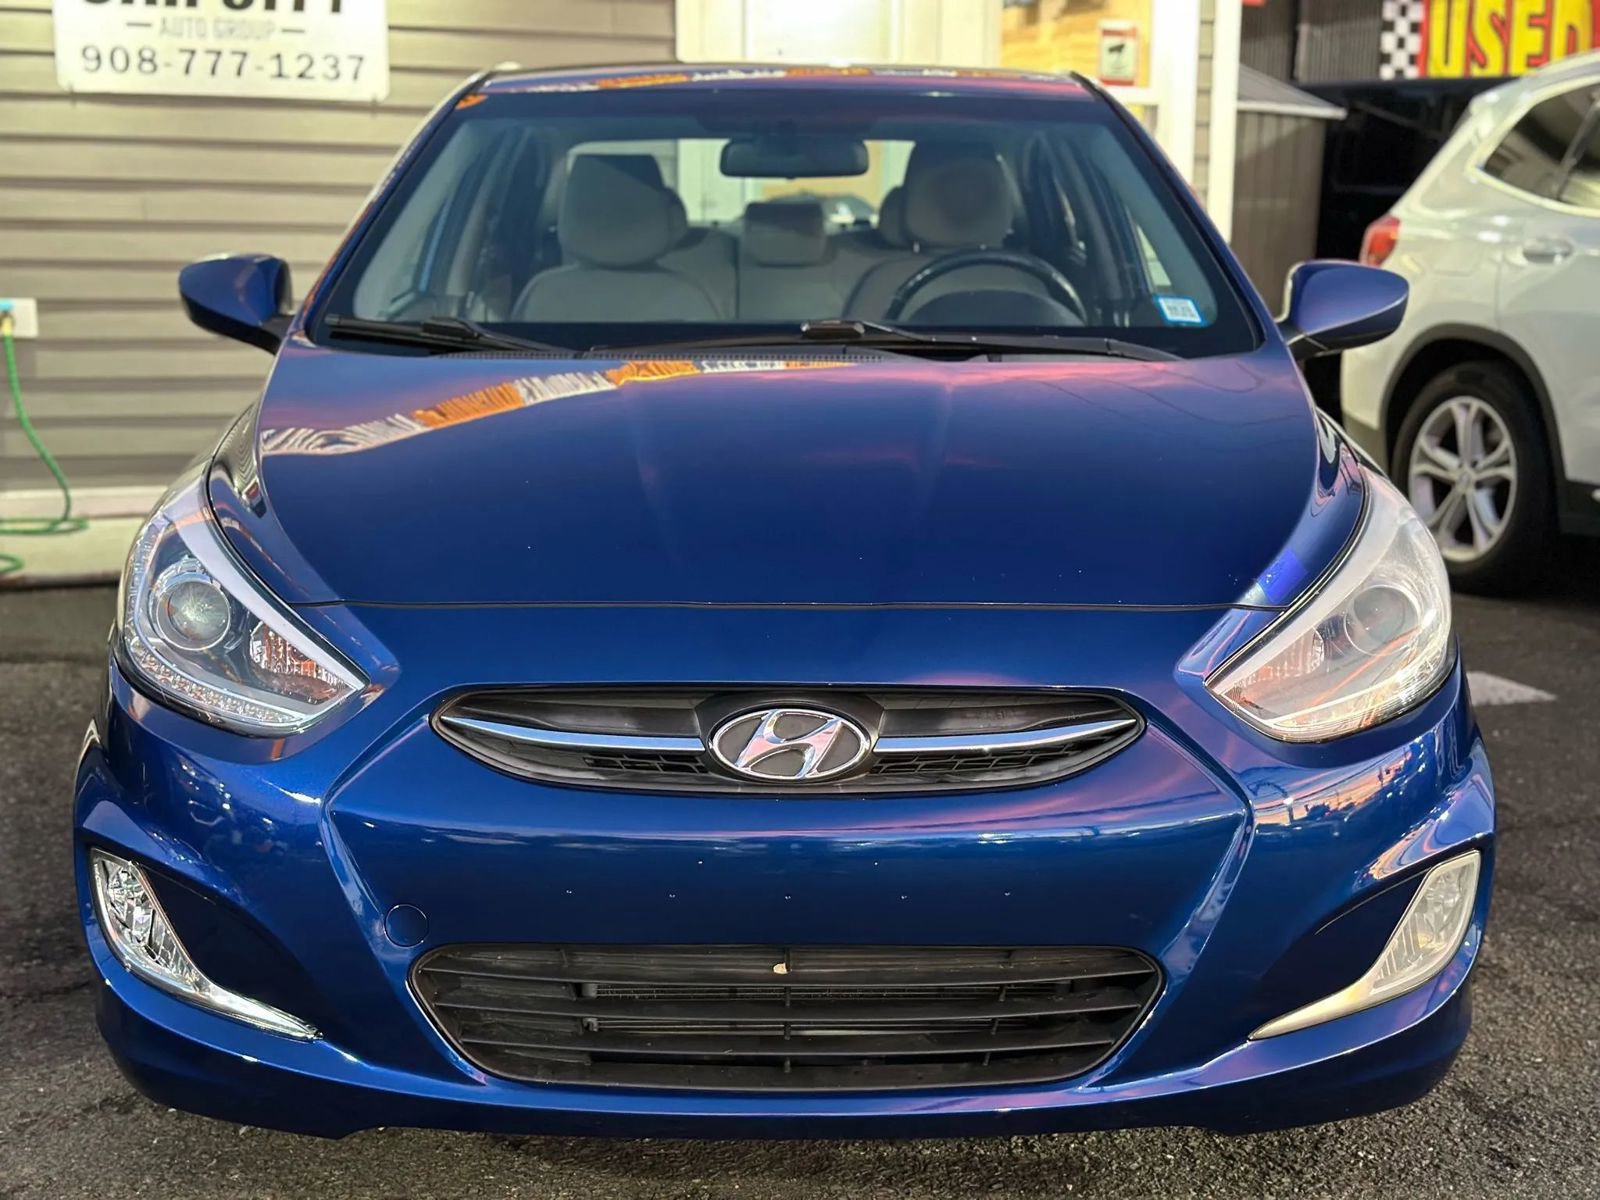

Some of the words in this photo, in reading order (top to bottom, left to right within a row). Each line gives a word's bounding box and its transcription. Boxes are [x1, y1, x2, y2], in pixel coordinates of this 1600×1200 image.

[159, 16, 207, 38] AUTO
[213, 17, 276, 40] GROUP
[1427, 0, 1593, 78] USED
[81, 46, 365, 81] 908-777-1237
